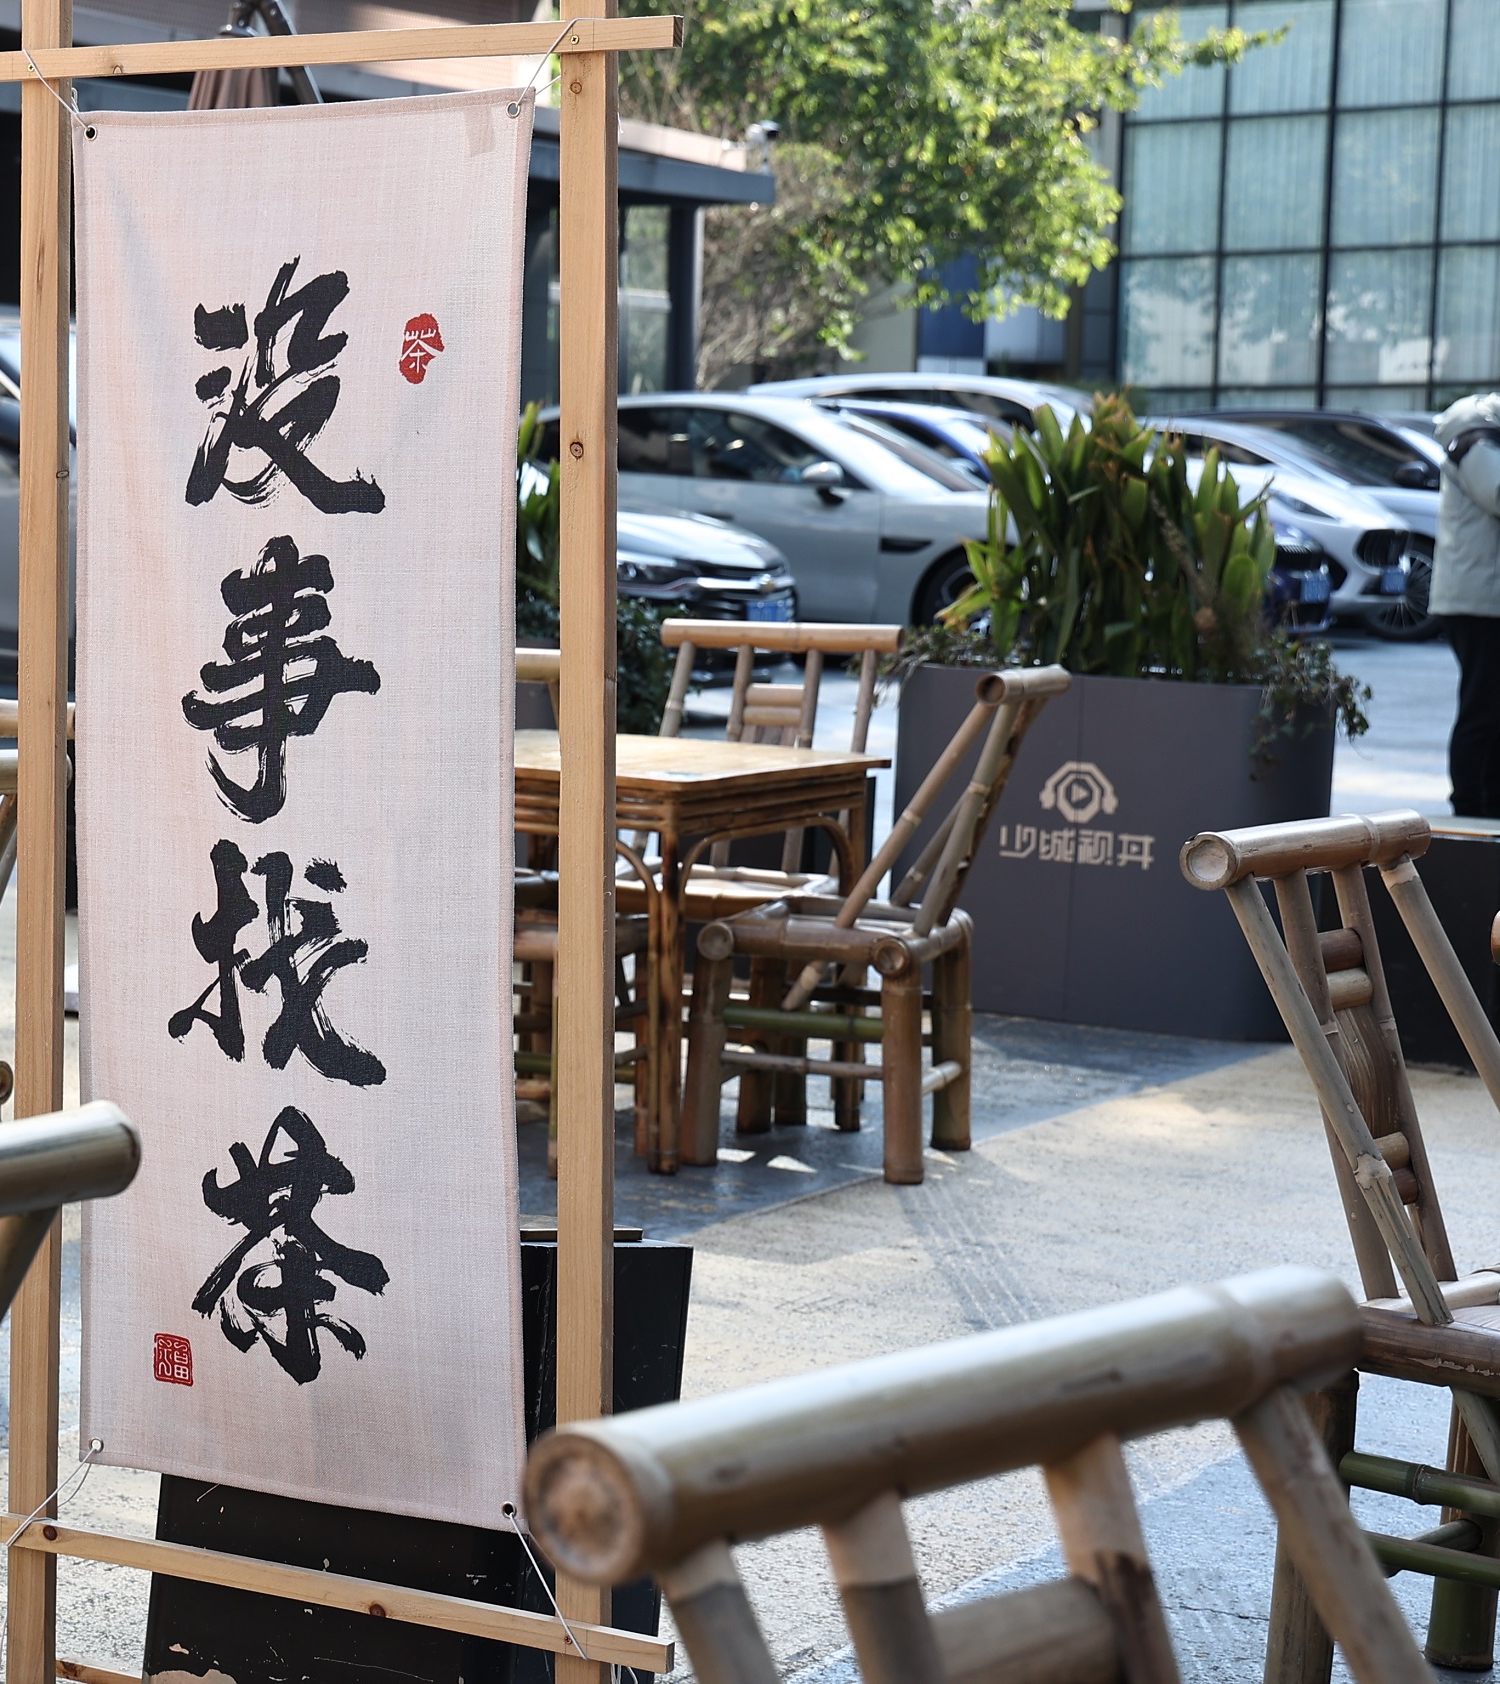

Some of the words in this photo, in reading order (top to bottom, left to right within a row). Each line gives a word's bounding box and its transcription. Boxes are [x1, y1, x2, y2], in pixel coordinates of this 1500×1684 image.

[400, 322, 440, 379] 茶
[168, 255, 390, 1386] 没事找茶
